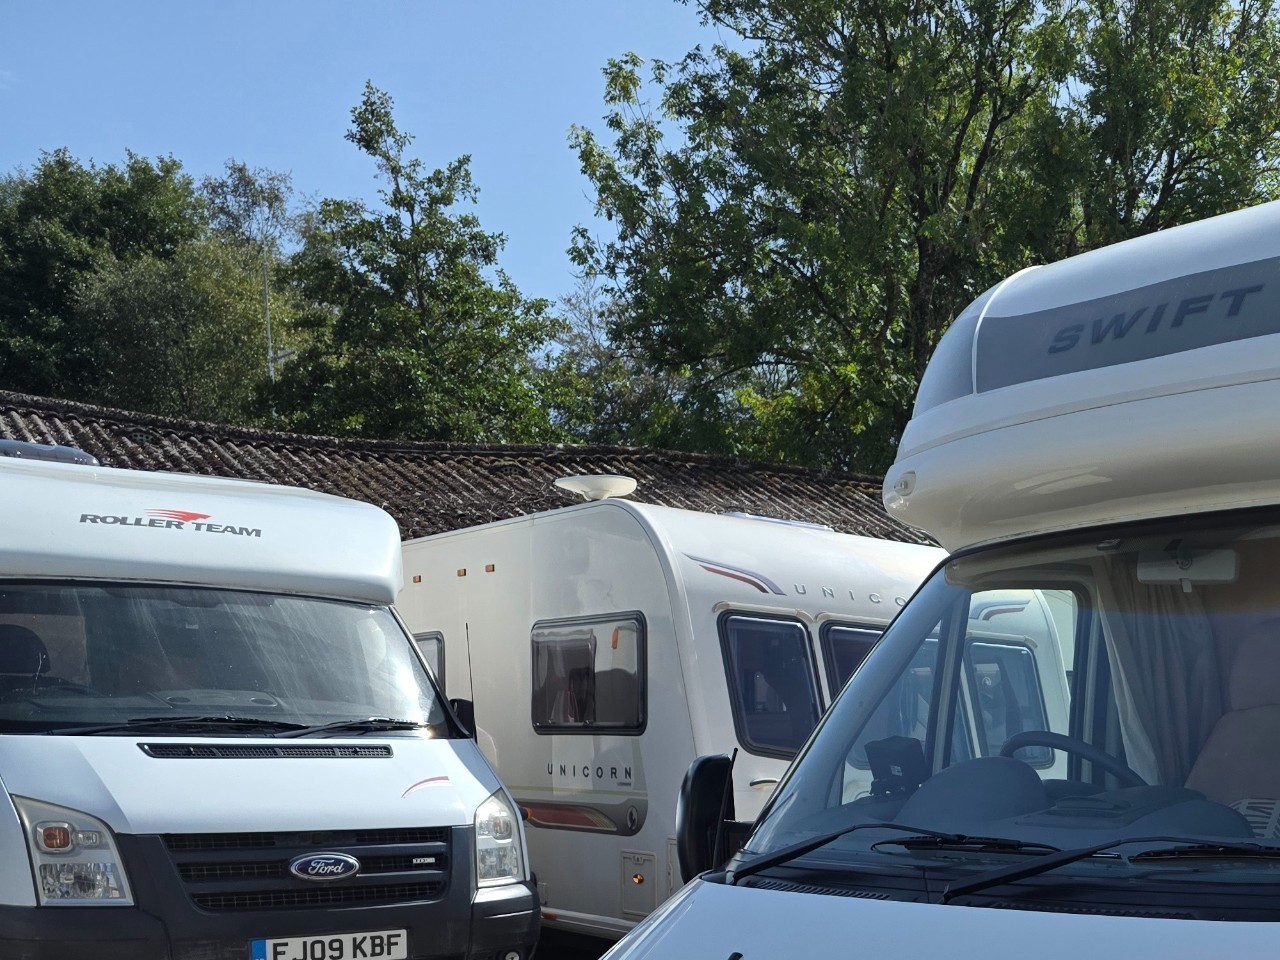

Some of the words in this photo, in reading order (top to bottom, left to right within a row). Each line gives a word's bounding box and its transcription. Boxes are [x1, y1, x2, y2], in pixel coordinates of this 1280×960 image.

[1047, 283, 1266, 356] SWIFT
[79, 513, 185, 530] ROLLER
[191, 521, 262, 538] TEAM
[793, 583, 908, 607] UNICO
[547, 763, 632, 780] UNICORN
[308, 859, 345, 875] Ford
[352, 933, 402, 959] KBF
